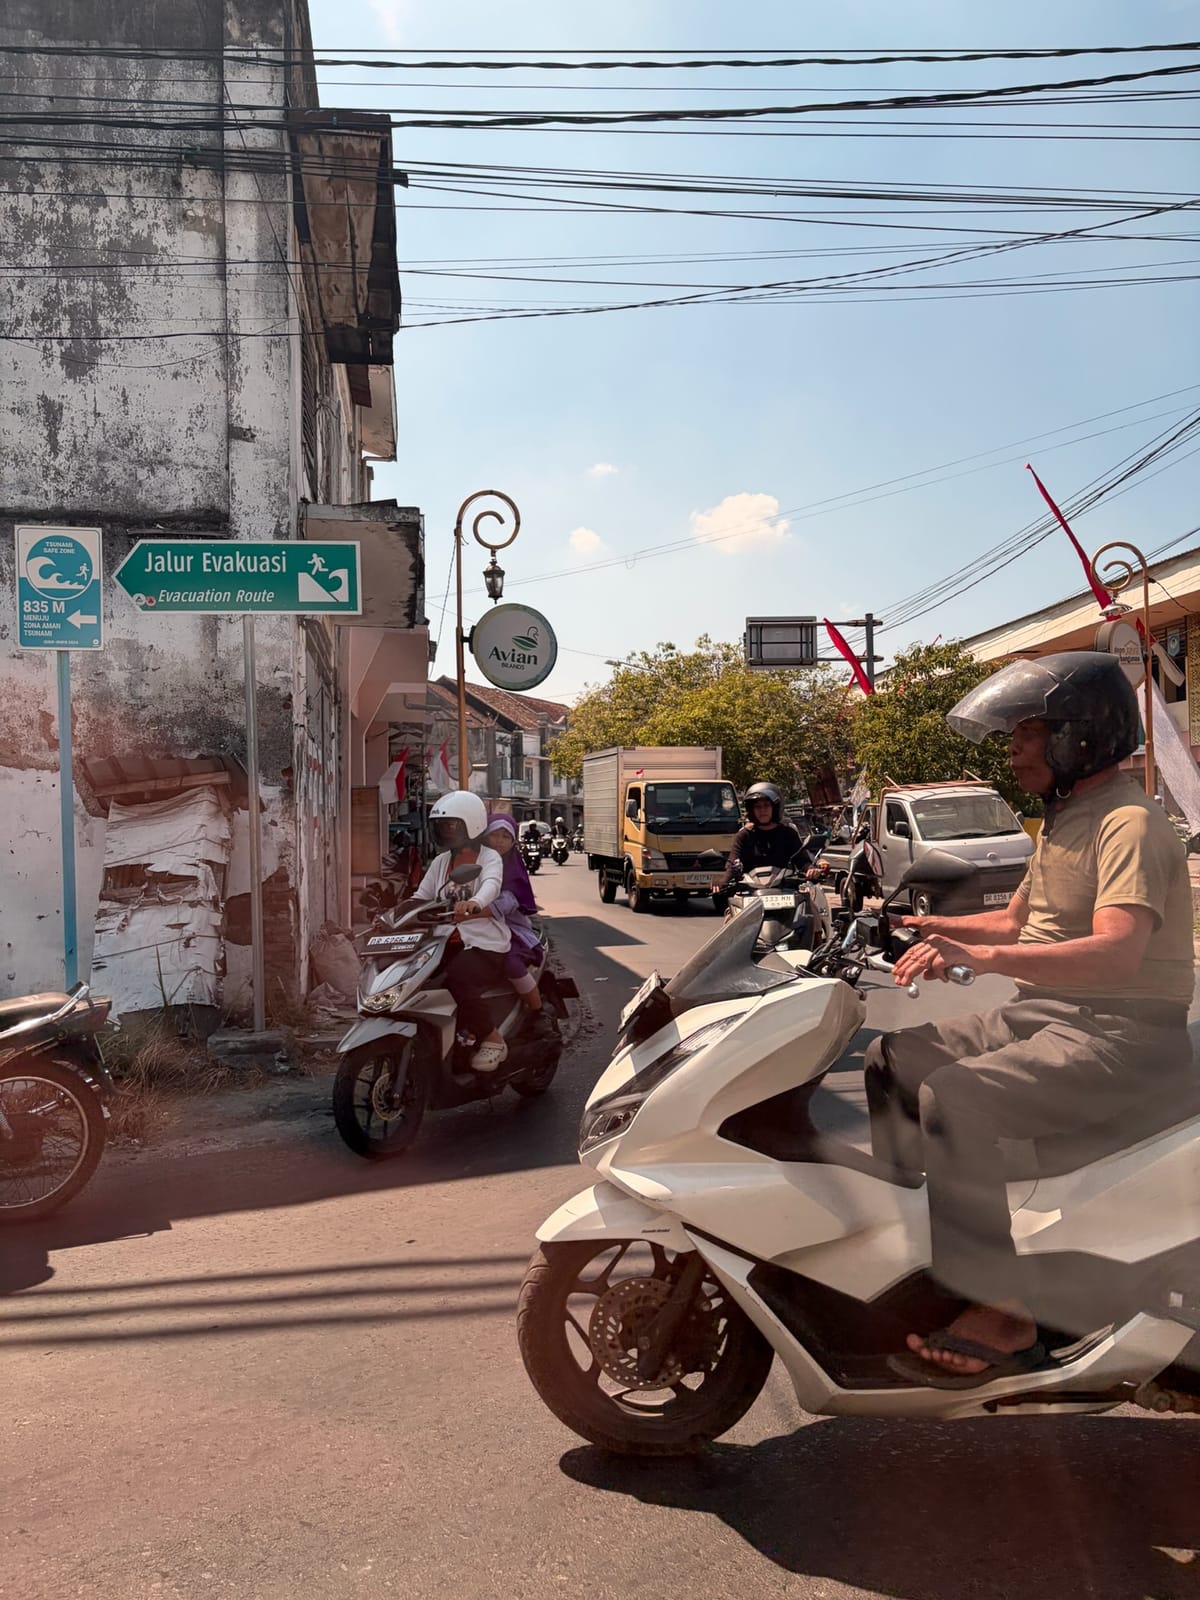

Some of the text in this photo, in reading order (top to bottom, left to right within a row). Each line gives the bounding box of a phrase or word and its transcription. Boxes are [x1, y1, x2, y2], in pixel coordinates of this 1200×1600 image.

[144, 551, 287, 573] Jalur Evakuasi
[158, 588, 275, 602] Evacuation Route
[23, 600, 65, 613] 835 M
[24, 629, 53, 637] TSUNAMI
[488, 646, 538, 665] Avian
[501, 662, 525, 671] BRANDS
